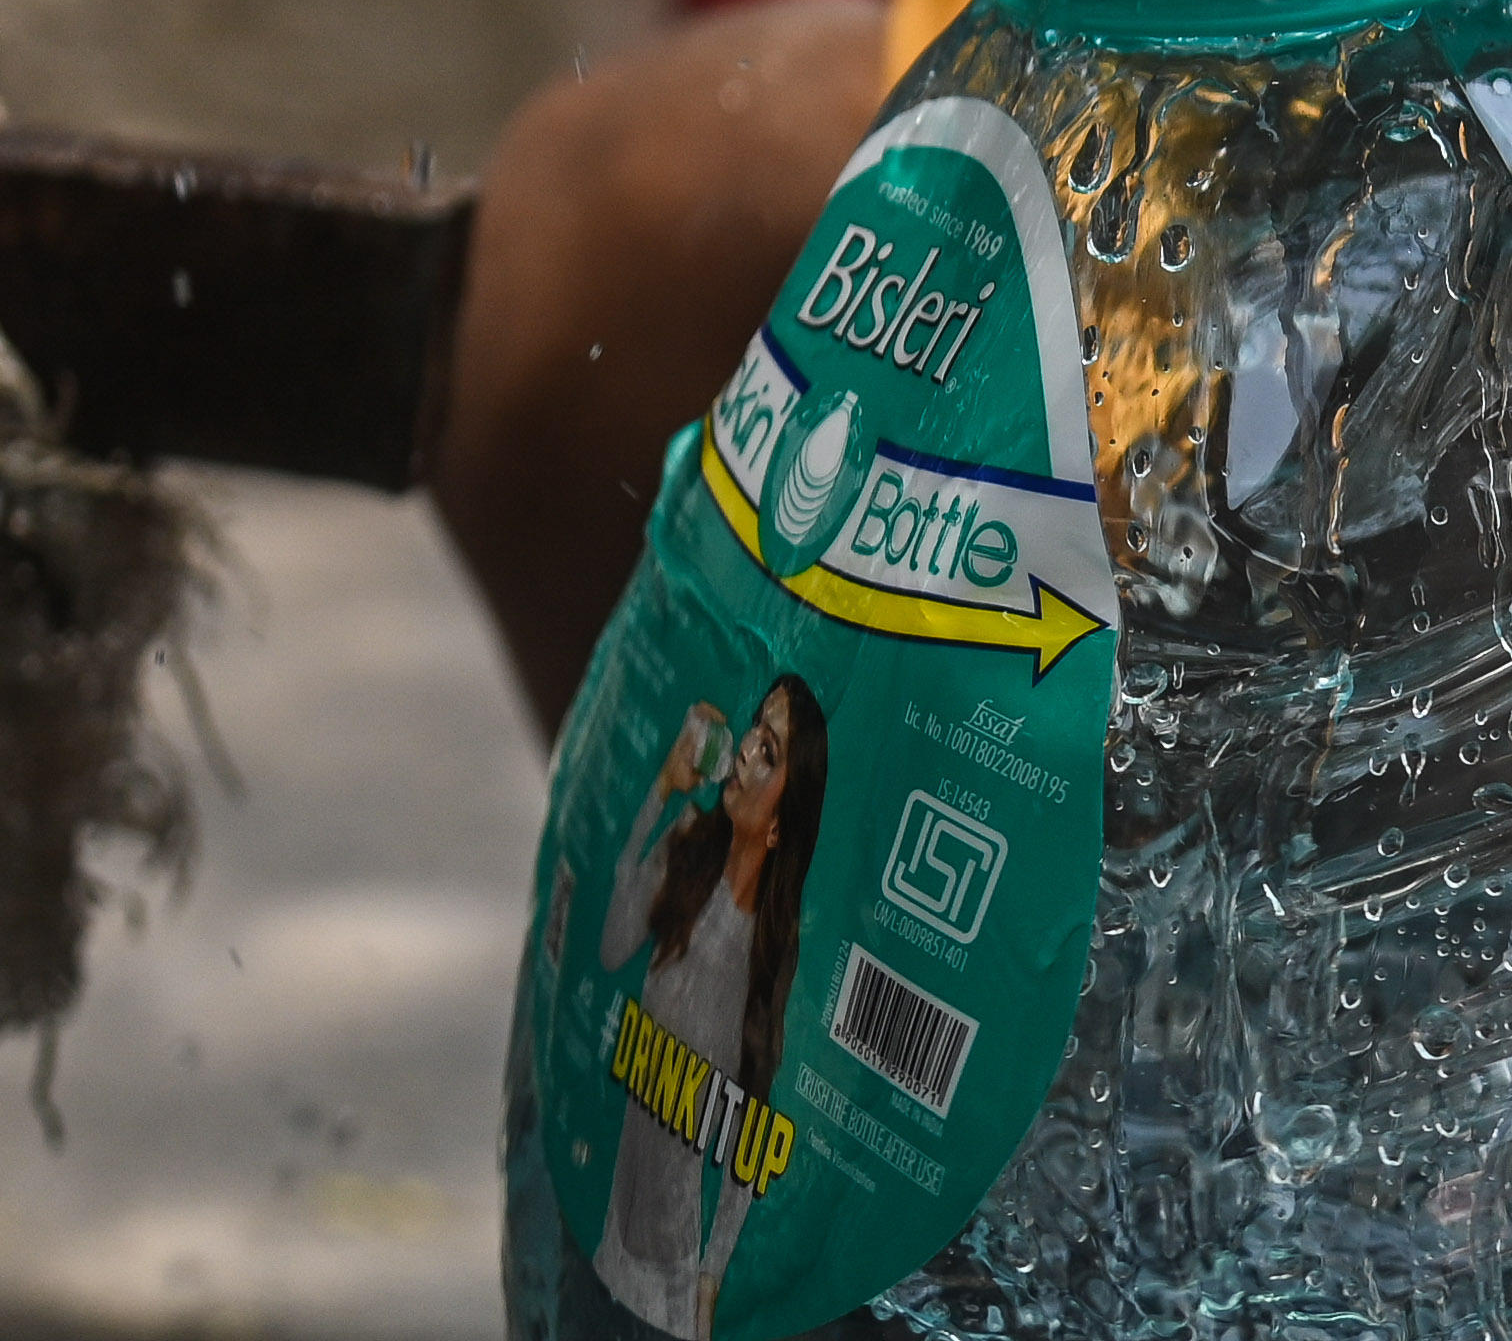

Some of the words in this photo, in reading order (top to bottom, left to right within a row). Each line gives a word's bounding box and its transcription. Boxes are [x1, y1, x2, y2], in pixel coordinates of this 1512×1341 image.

[878, 181, 928, 216] rusted
[929, 205, 964, 239] since
[964, 219, 1004, 261] 1969
[797, 223, 996, 384] Bisleri
[851, 468, 1019, 588] Bottle
[904, 701, 921, 730] Lic.
[963, 699, 1027, 746] fssai
[798, 1067, 831, 1110] CRUSH
[828, 1091, 849, 1126] THE
[847, 1107, 885, 1153] BOTTLE
[883, 1136, 917, 1175] AFTER
[916, 1156, 941, 1192] USE
